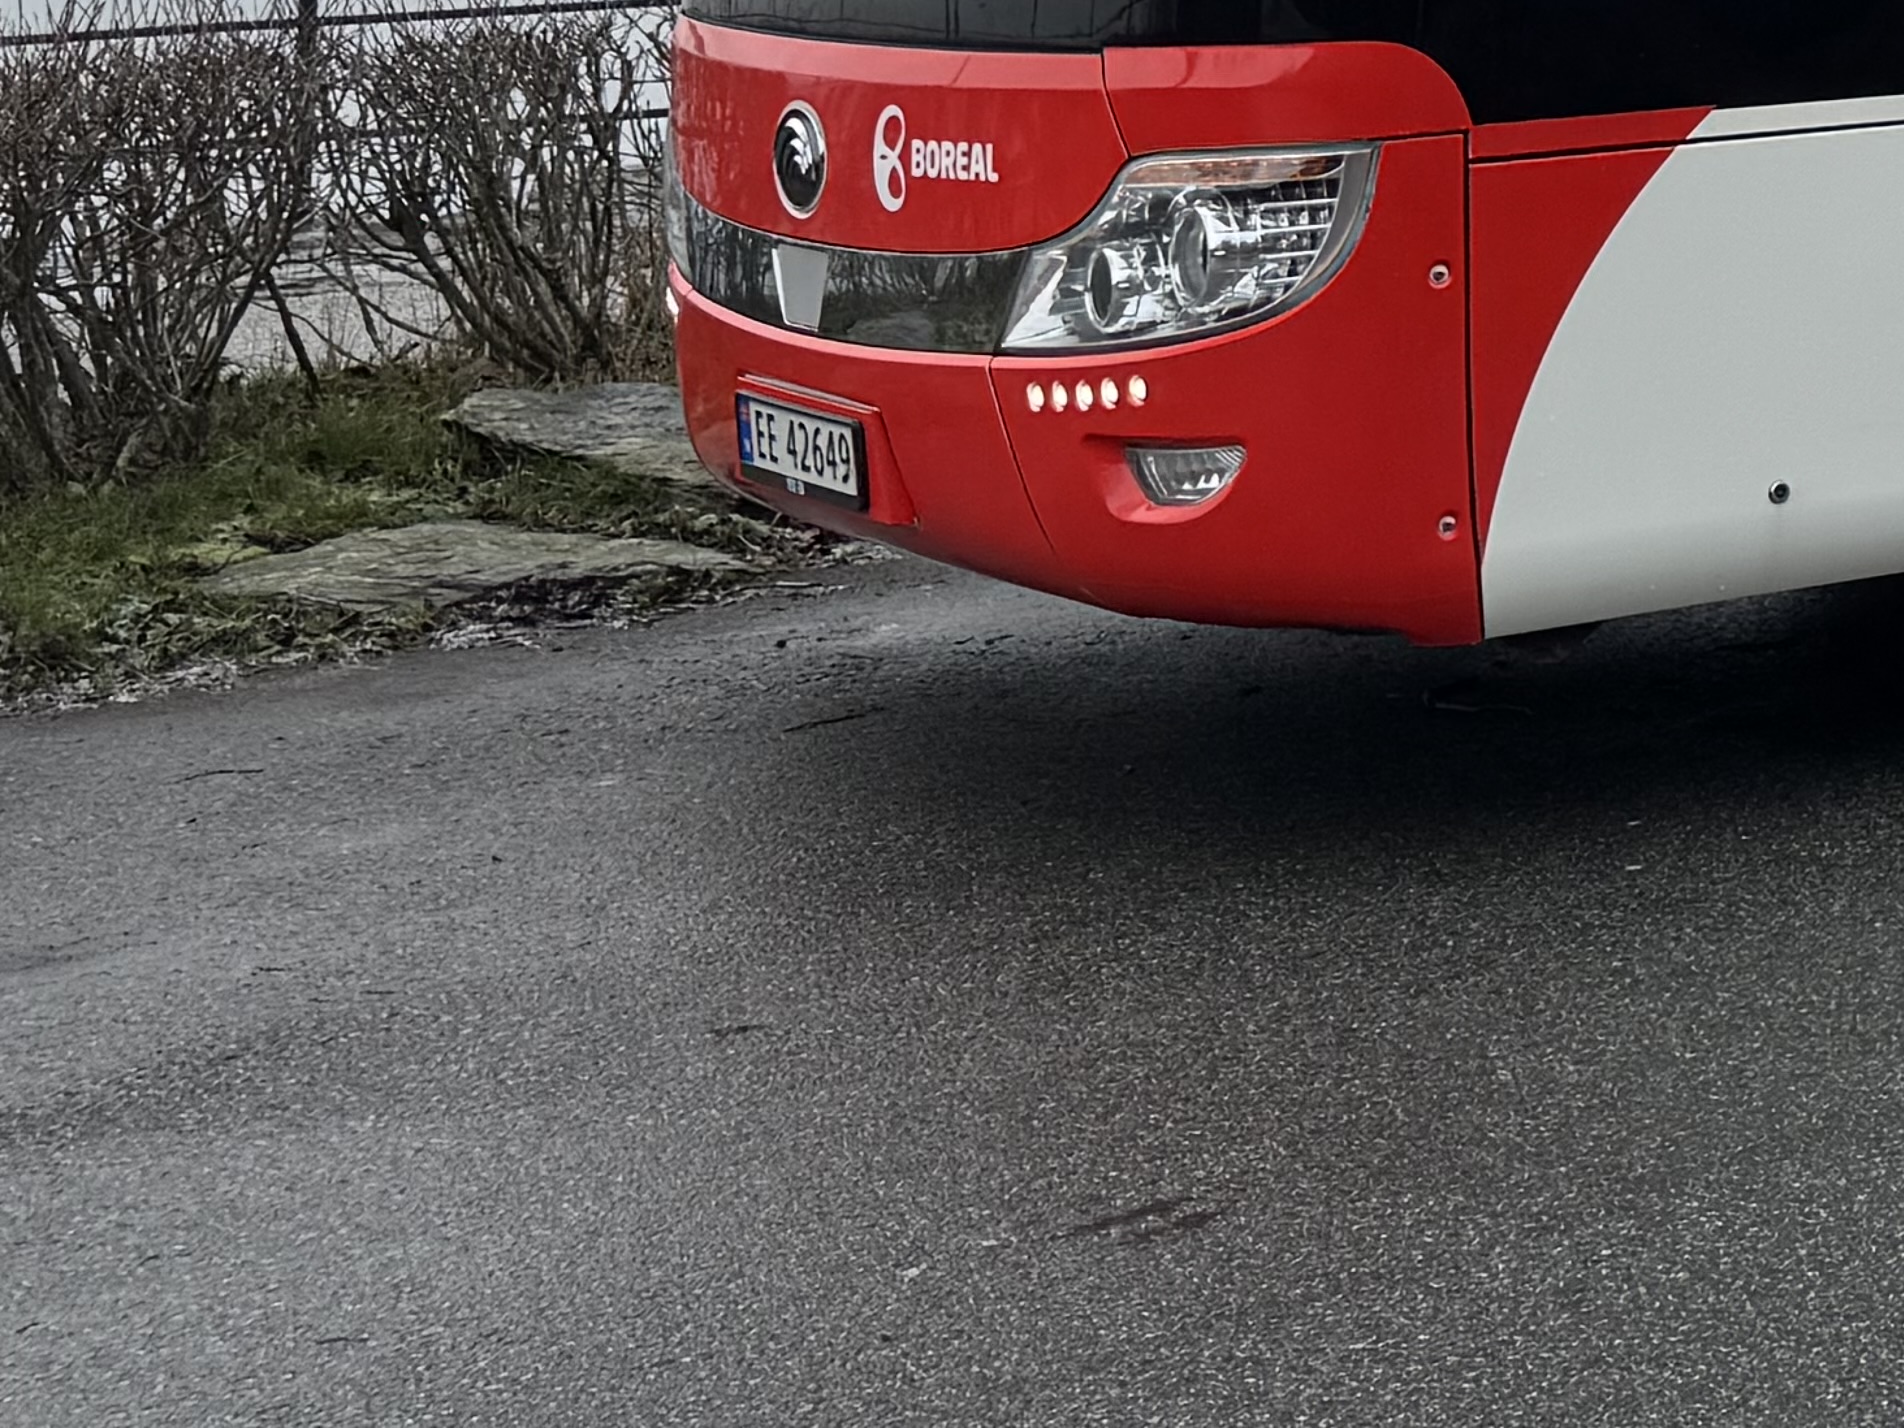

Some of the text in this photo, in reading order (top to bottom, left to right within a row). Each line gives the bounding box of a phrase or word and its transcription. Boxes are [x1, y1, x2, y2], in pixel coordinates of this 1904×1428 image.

[910, 138, 999, 183] BOREAL
[755, 410, 850, 484] EE 42649
